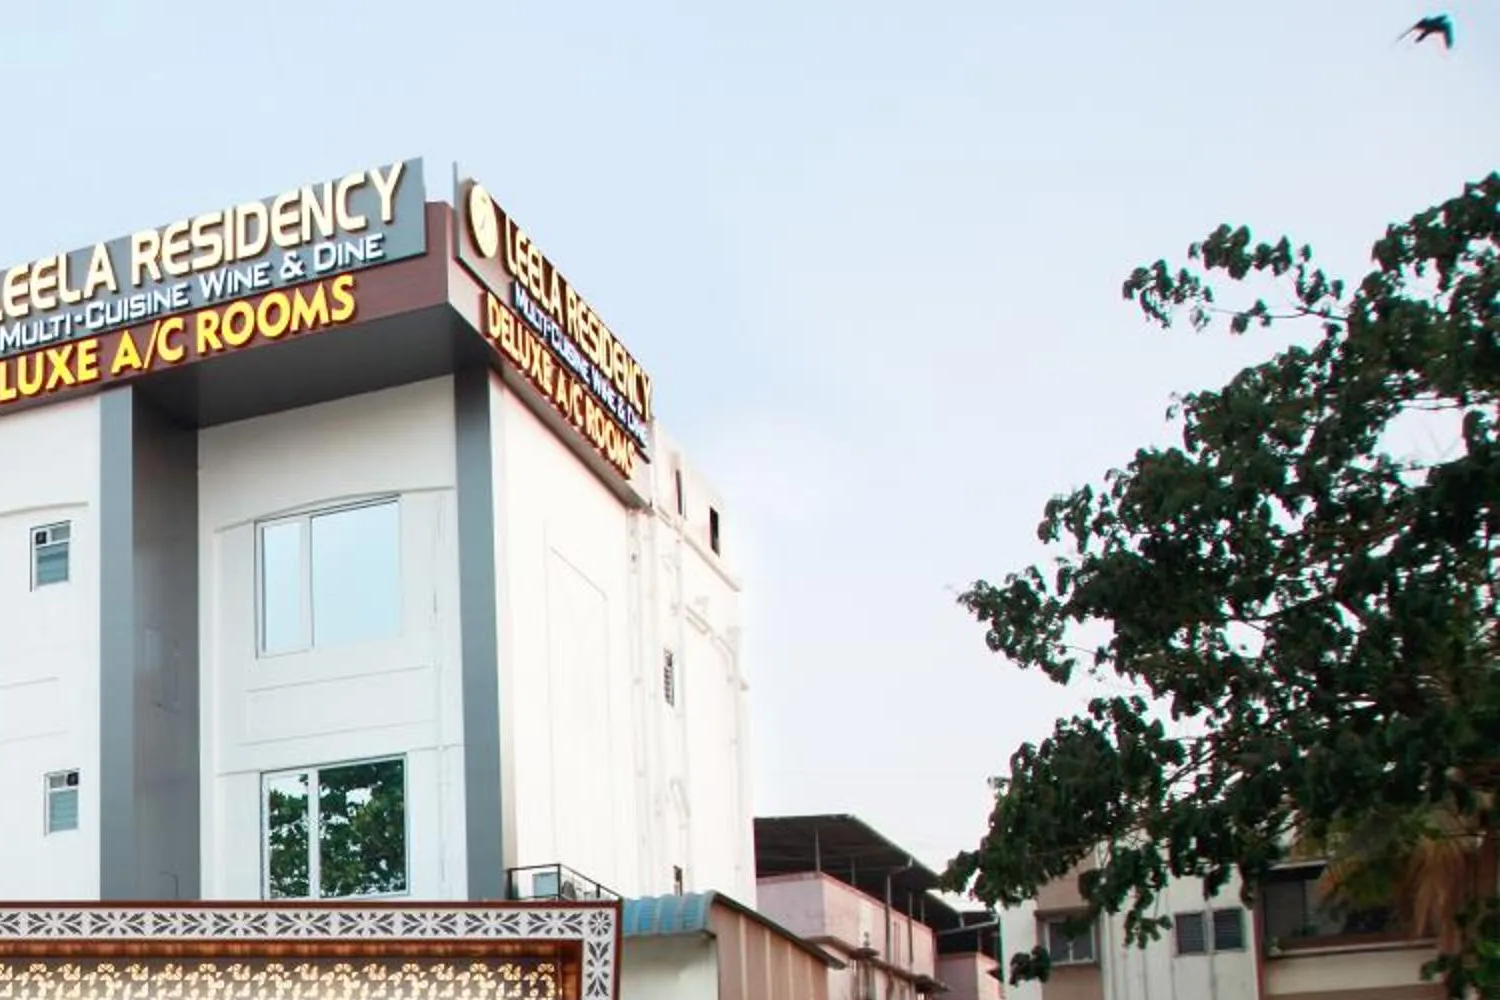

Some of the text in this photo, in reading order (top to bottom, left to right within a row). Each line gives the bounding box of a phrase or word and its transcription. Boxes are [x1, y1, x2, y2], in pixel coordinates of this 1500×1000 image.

[131, 161, 404, 285] RESIDENCY
[0, 233, 385, 351] MULTI-CUISINE WINE & DINE
[112, 315, 184, 374] A/C
[197, 275, 357, 357] ROOMS
[505, 213, 653, 421] LEELA RESIDENCY
[487, 291, 637, 480] DELUXE A/C ROOMS
